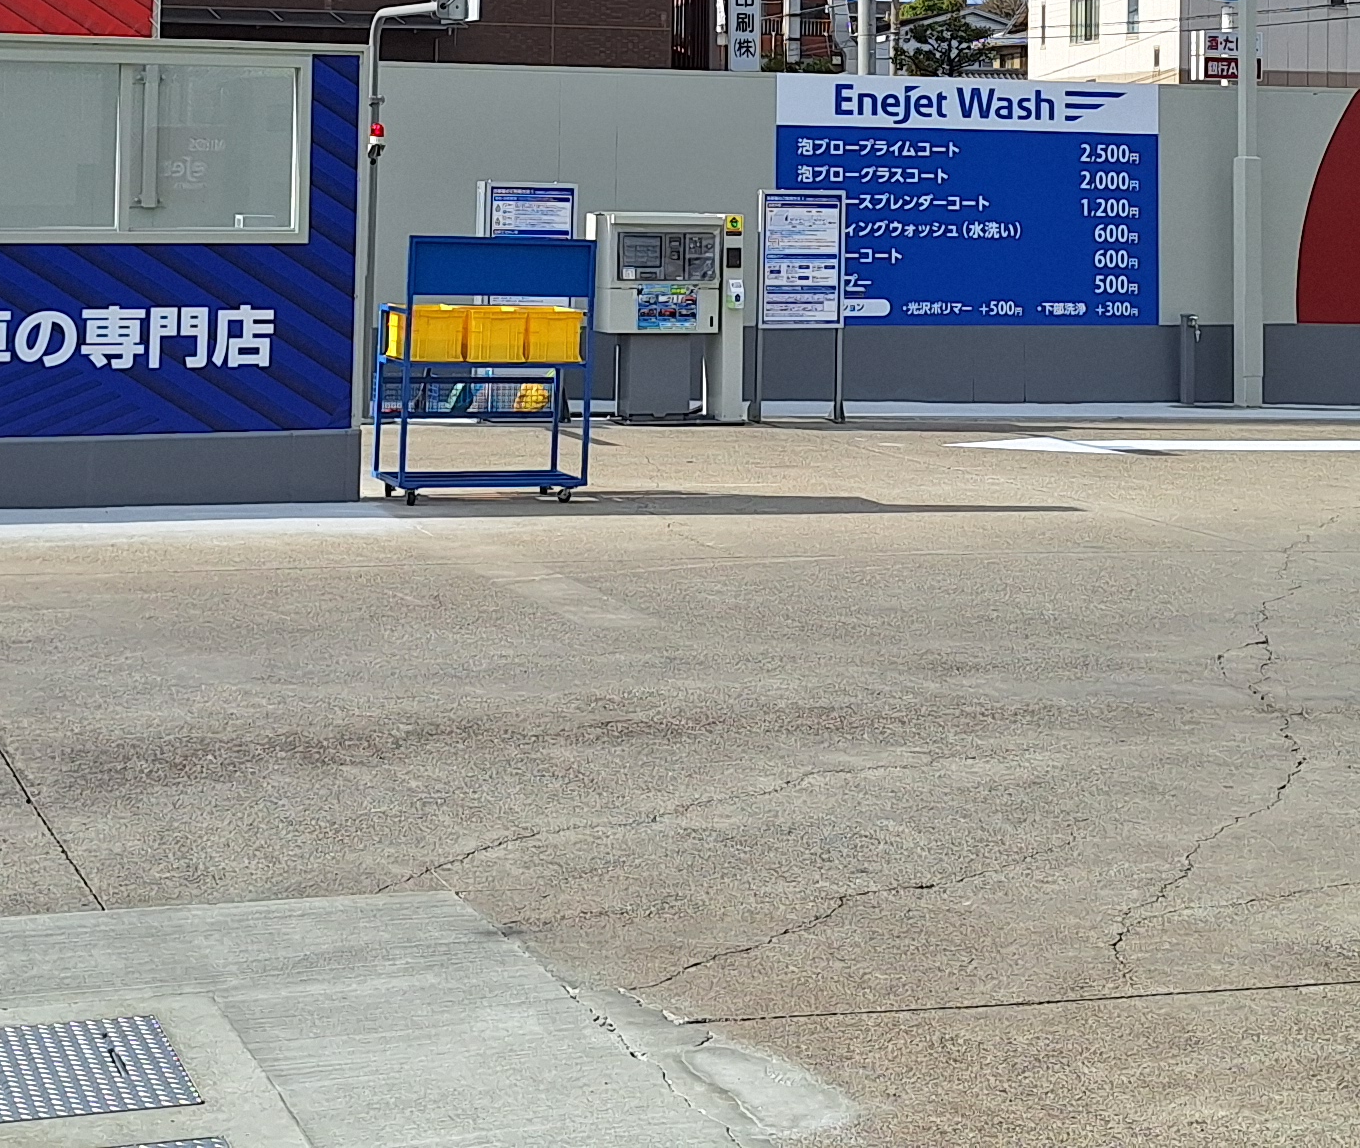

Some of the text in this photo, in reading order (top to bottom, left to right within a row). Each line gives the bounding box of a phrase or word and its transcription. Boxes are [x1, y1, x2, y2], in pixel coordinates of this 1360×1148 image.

[1207, 60, 1238, 76] 銀行A
[834, 83, 1055, 125] Enejet Wash
[797, 137, 1139, 164] 泡ブロープライムコート 2,500円
[797, 165, 1139, 191] 泡ブローグラスコート 2,000円
[845, 193, 1139, 218] ースプレンダーコート 1,200円
[845, 220, 1139, 244] ィングウォッシュ(水洗い) 600円
[845, 247, 1138, 269] ーコート 600円
[1094, 275, 1138, 295] 500円
